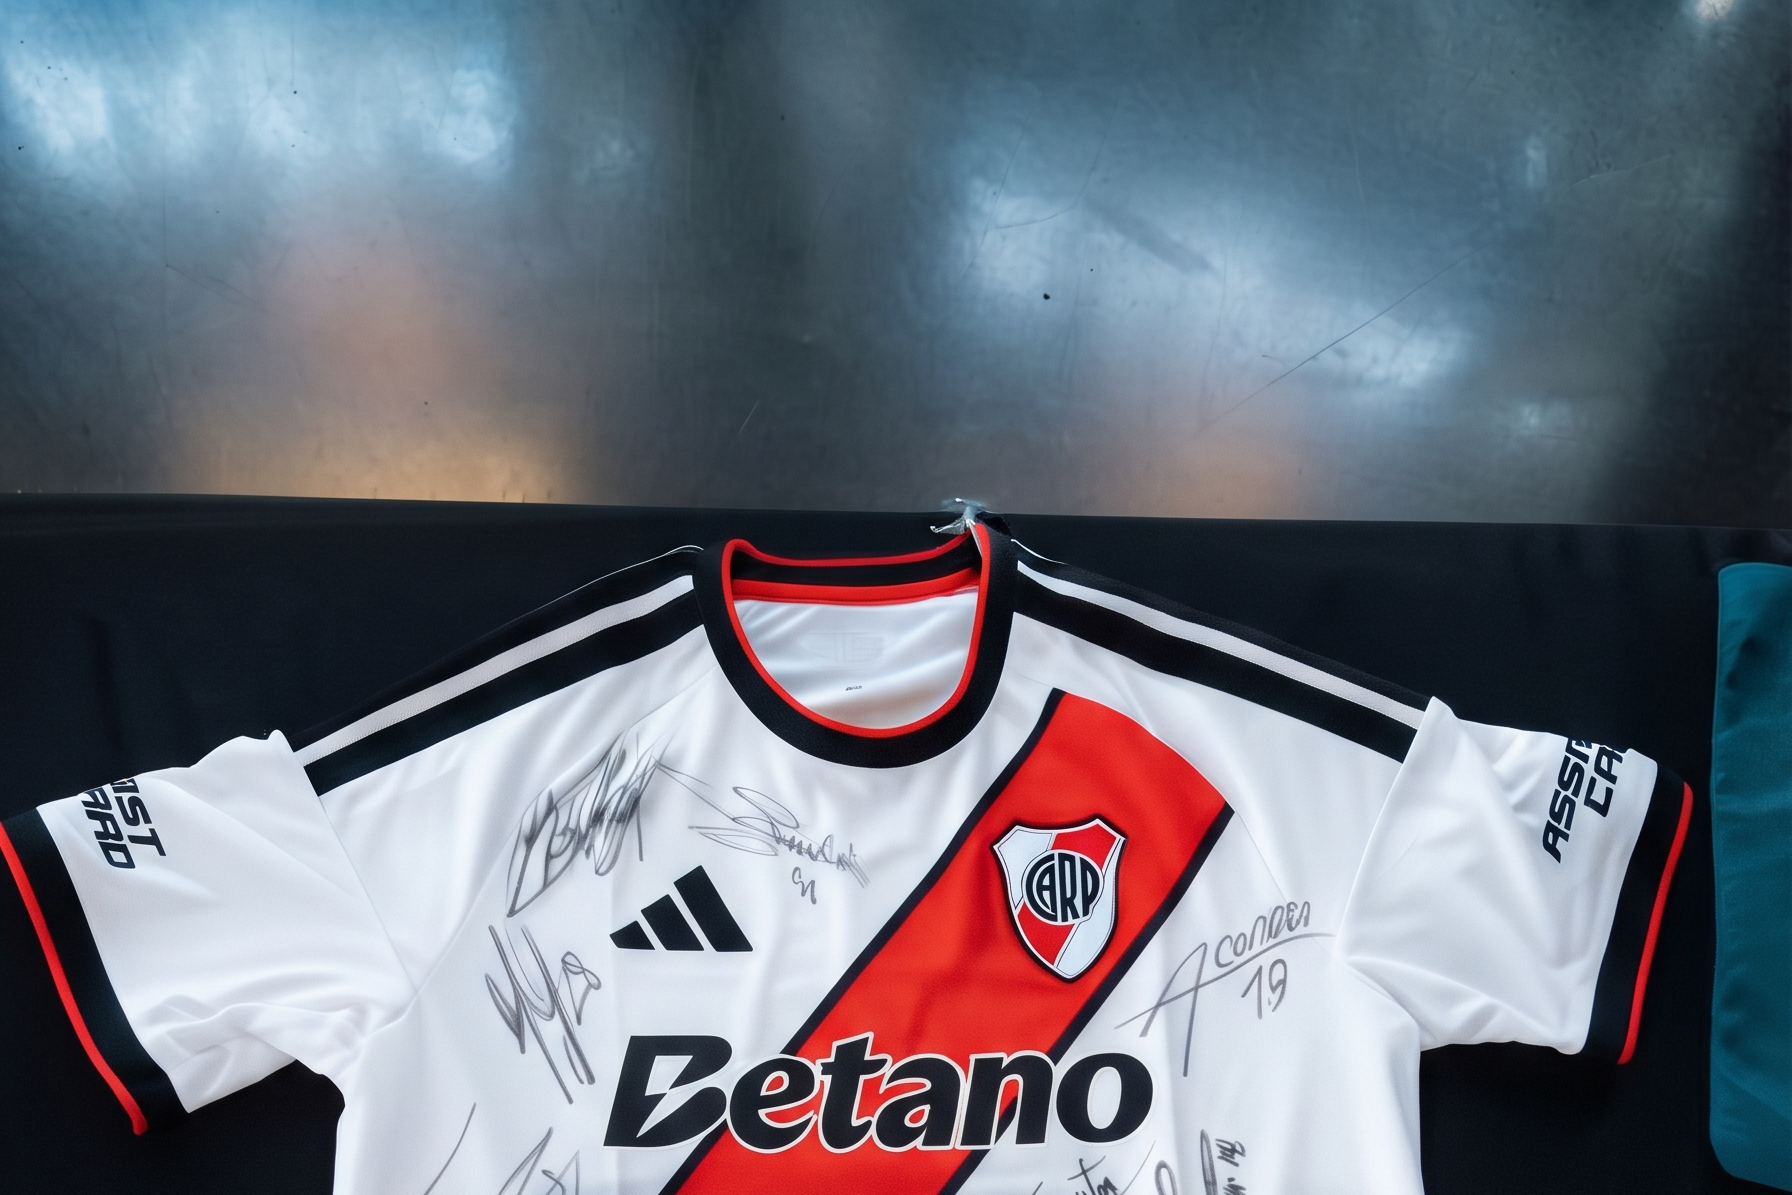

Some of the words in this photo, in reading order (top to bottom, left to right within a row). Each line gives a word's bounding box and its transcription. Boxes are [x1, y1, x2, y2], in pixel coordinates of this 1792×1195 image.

[1025, 852, 1101, 923] CARP
[1240, 958, 1288, 1020] 19
[602, 1031, 1158, 1153] Betano
